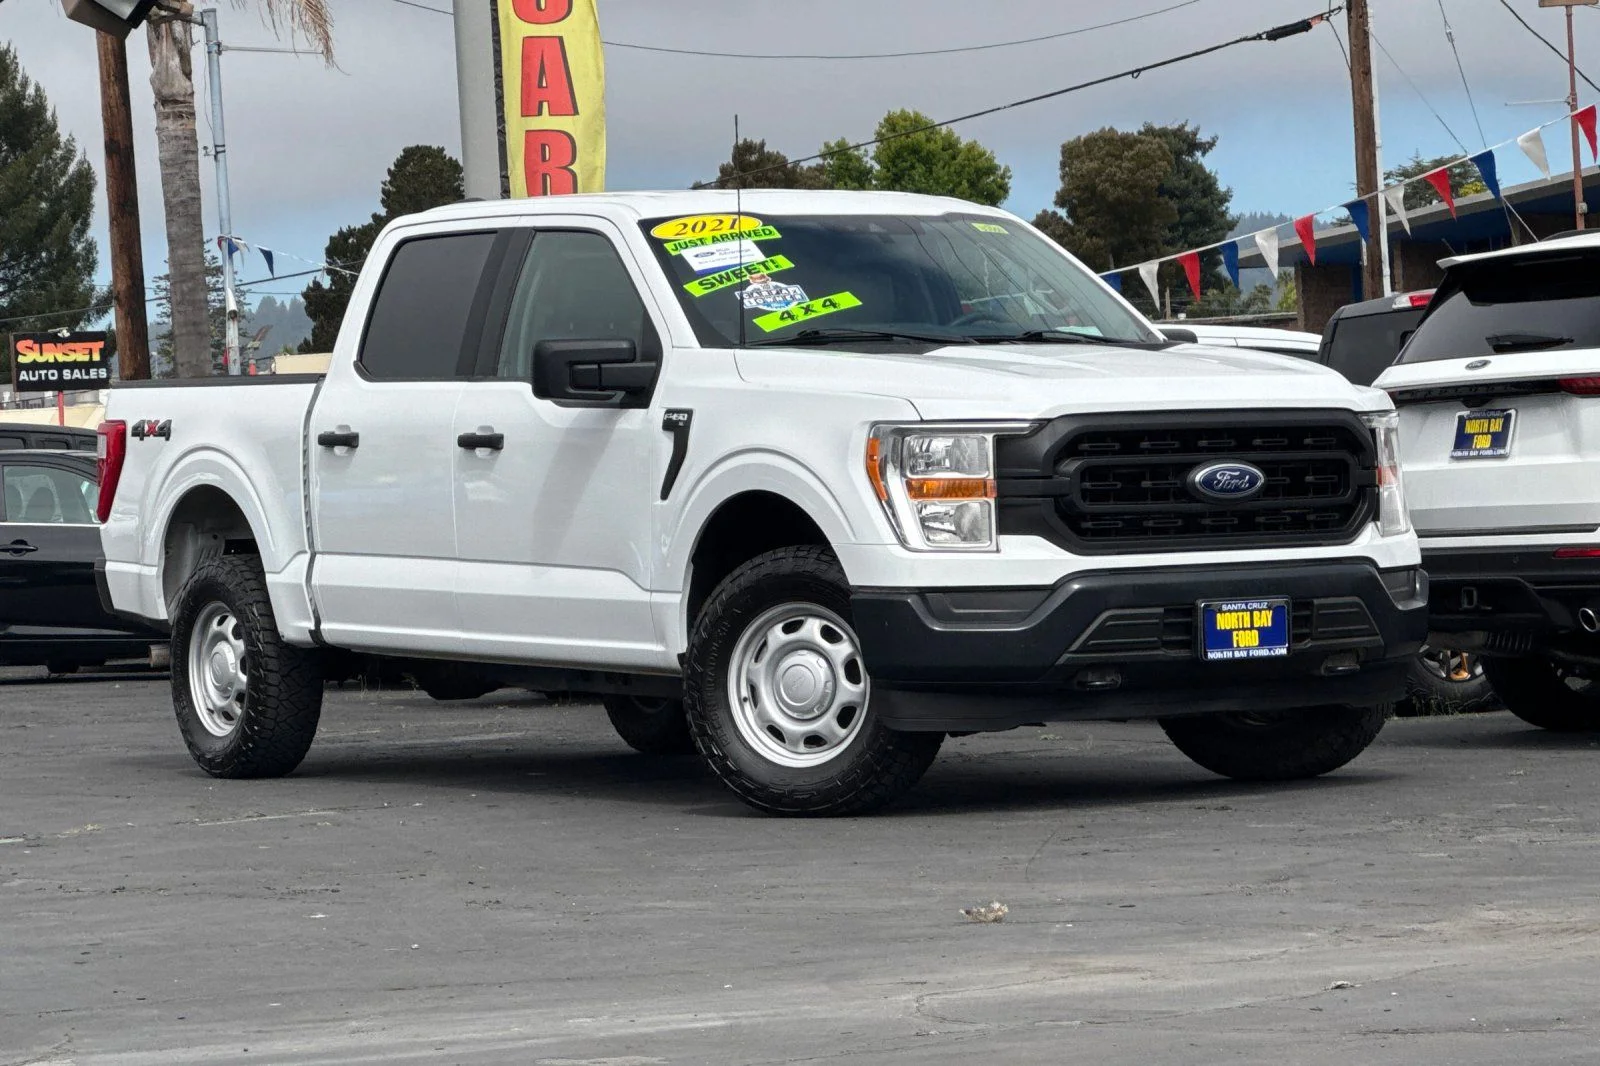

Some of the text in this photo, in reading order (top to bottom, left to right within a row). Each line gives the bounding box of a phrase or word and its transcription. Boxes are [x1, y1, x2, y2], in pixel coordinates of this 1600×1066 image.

[674, 218, 739, 236] 2021
[671, 228, 773, 252] JUST ARRIVED
[697, 258, 780, 291] SWEET!
[16, 339, 105, 364] SUNSET
[19, 368, 107, 381] AUTO SALES
[1465, 418, 1504, 433] NORTH BAY
[1472, 434, 1492, 449] FORD
[1213, 470, 1250, 490] Ford
[1222, 603, 1247, 611] SANTA
[1216, 610, 1272, 630] NORTH BAY
[1232, 630, 1259, 647] FORD
[1207, 647, 1287, 659] NORTH BAY FORD.COM
